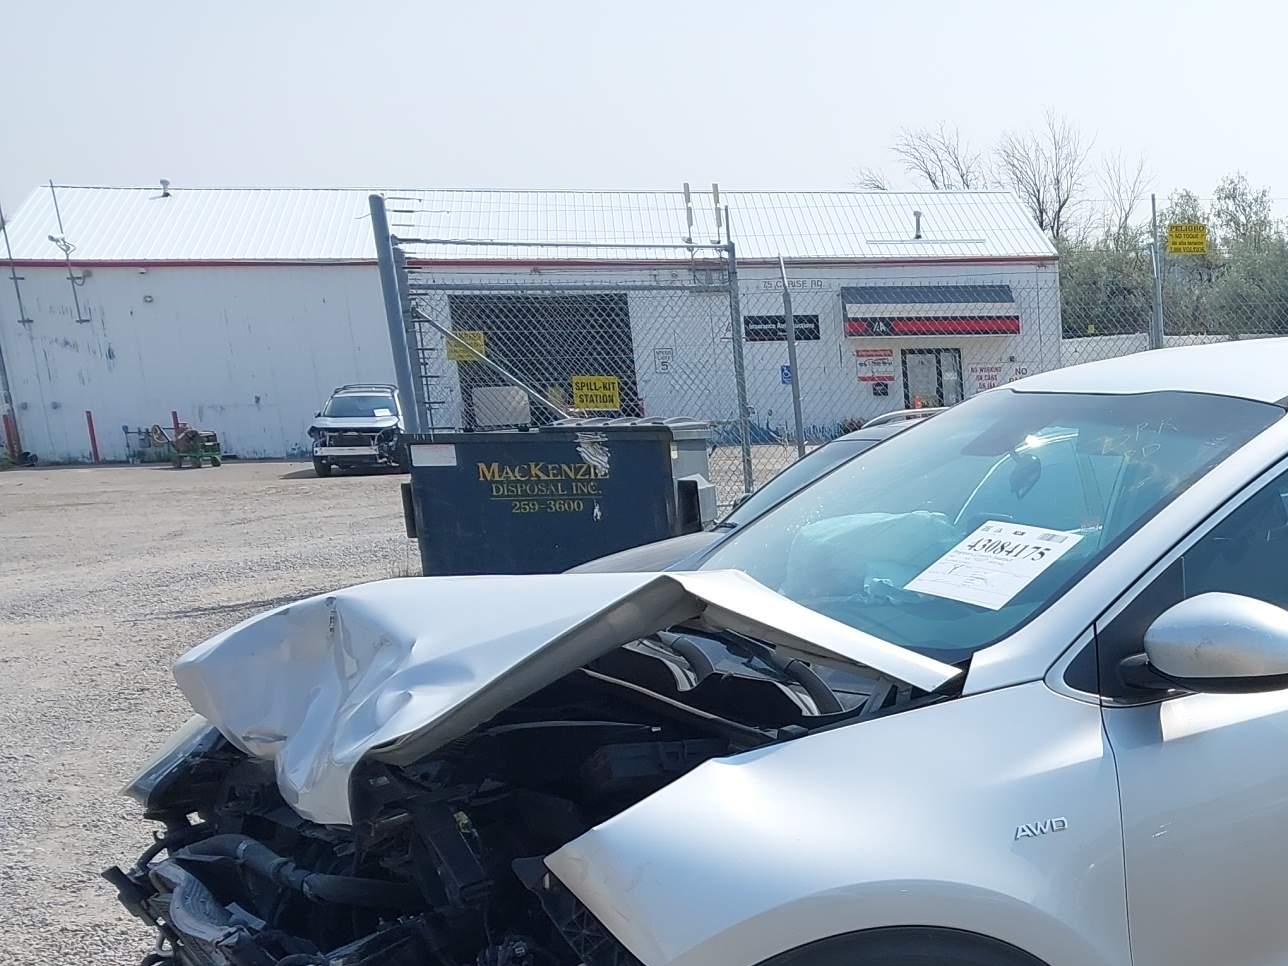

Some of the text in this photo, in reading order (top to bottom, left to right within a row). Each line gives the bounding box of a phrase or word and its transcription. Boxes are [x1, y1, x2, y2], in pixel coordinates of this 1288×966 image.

[775, 280, 807, 289] CRISE
[660, 361, 669, 371] 5
[1014, 367, 1028, 376] NO
[575, 381, 616, 391] SPILL-KIT
[578, 394, 615, 404] STATION
[491, 482, 603, 496] DISPOSAL INC.
[512, 500, 584, 513] 259-3600
[967, 538, 1052, 562] 43084175
[1014, 816, 1068, 841] AWD
